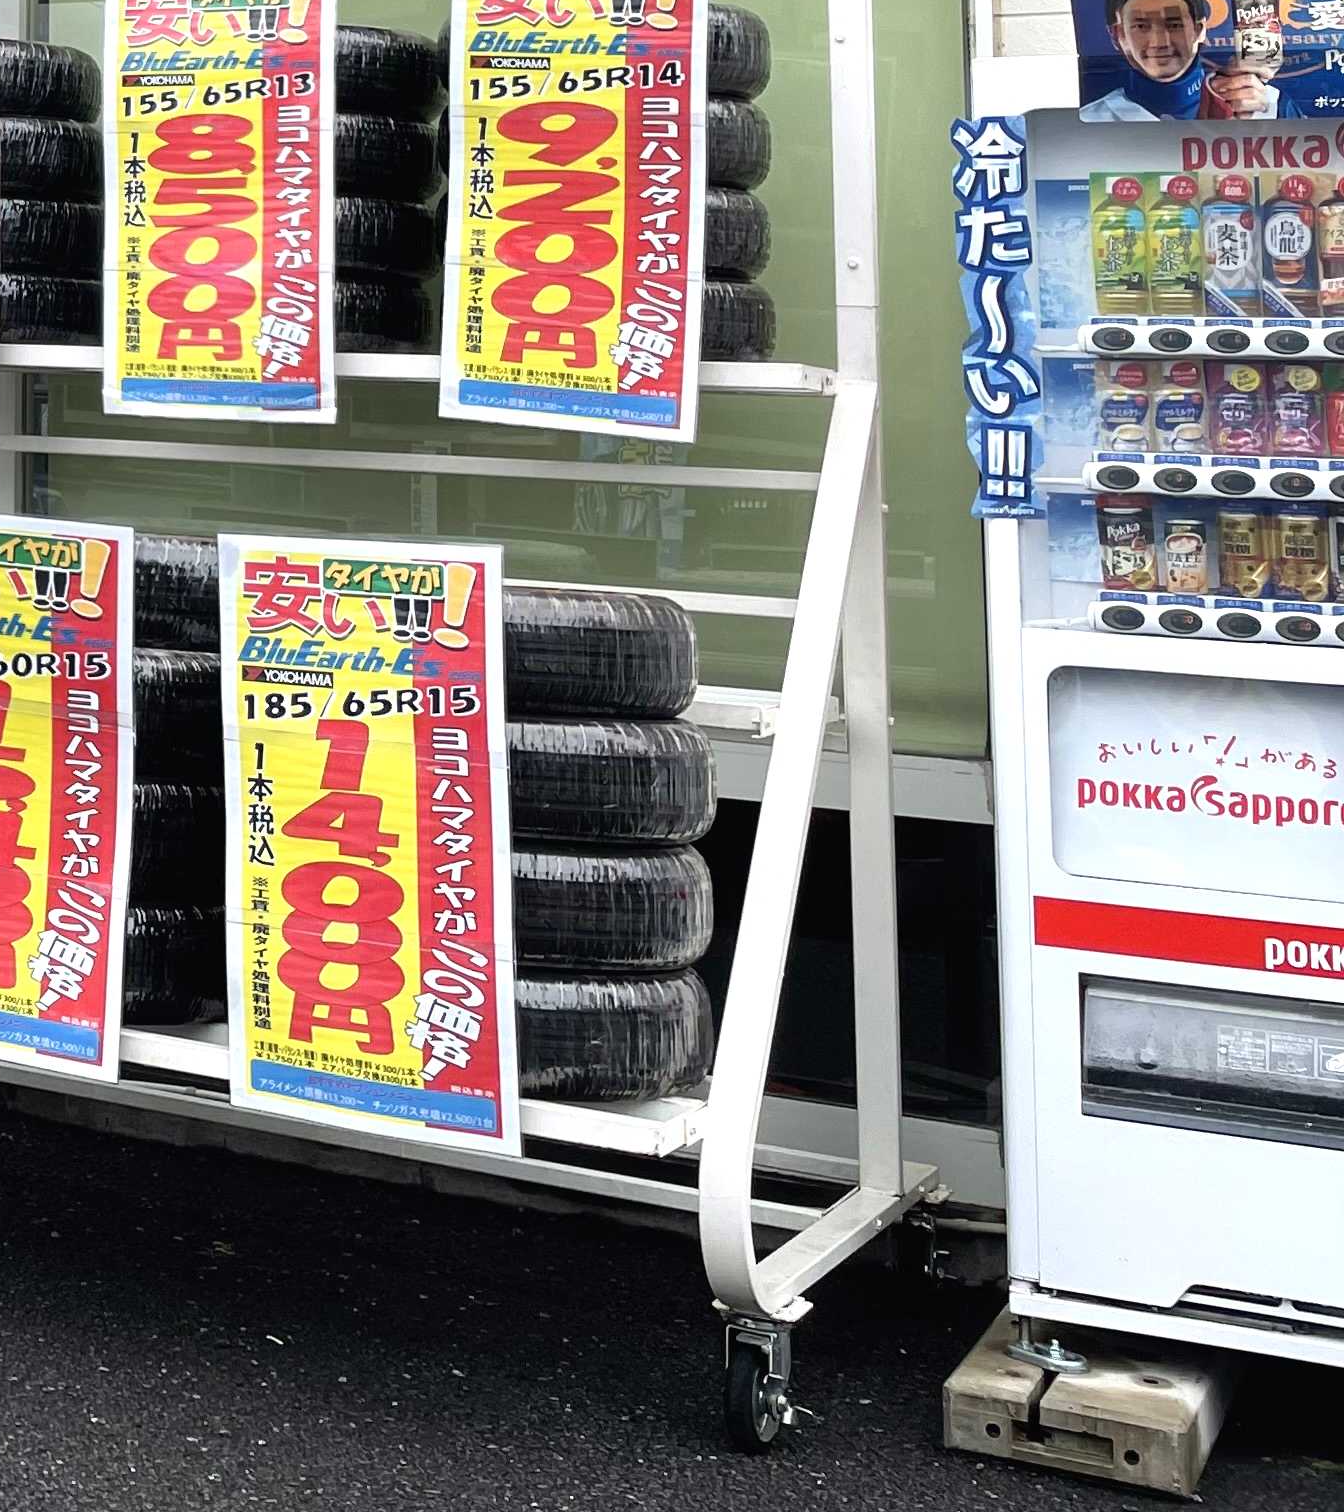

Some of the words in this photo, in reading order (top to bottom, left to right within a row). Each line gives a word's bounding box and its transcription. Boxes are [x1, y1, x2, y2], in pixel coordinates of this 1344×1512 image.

[140, 75, 194, 86] YOKOHAMA
[489, 58, 550, 69] YOKOHAMA
[124, 132, 146, 228] 1本税込
[469, 117, 494, 219] 1本税込
[1216, 223, 1240, 267] 麦茶
[323, 560, 444, 595] タイヤが
[263, 668, 333, 688] YOKOHAMA
[247, 742, 275, 866] 1本税込
